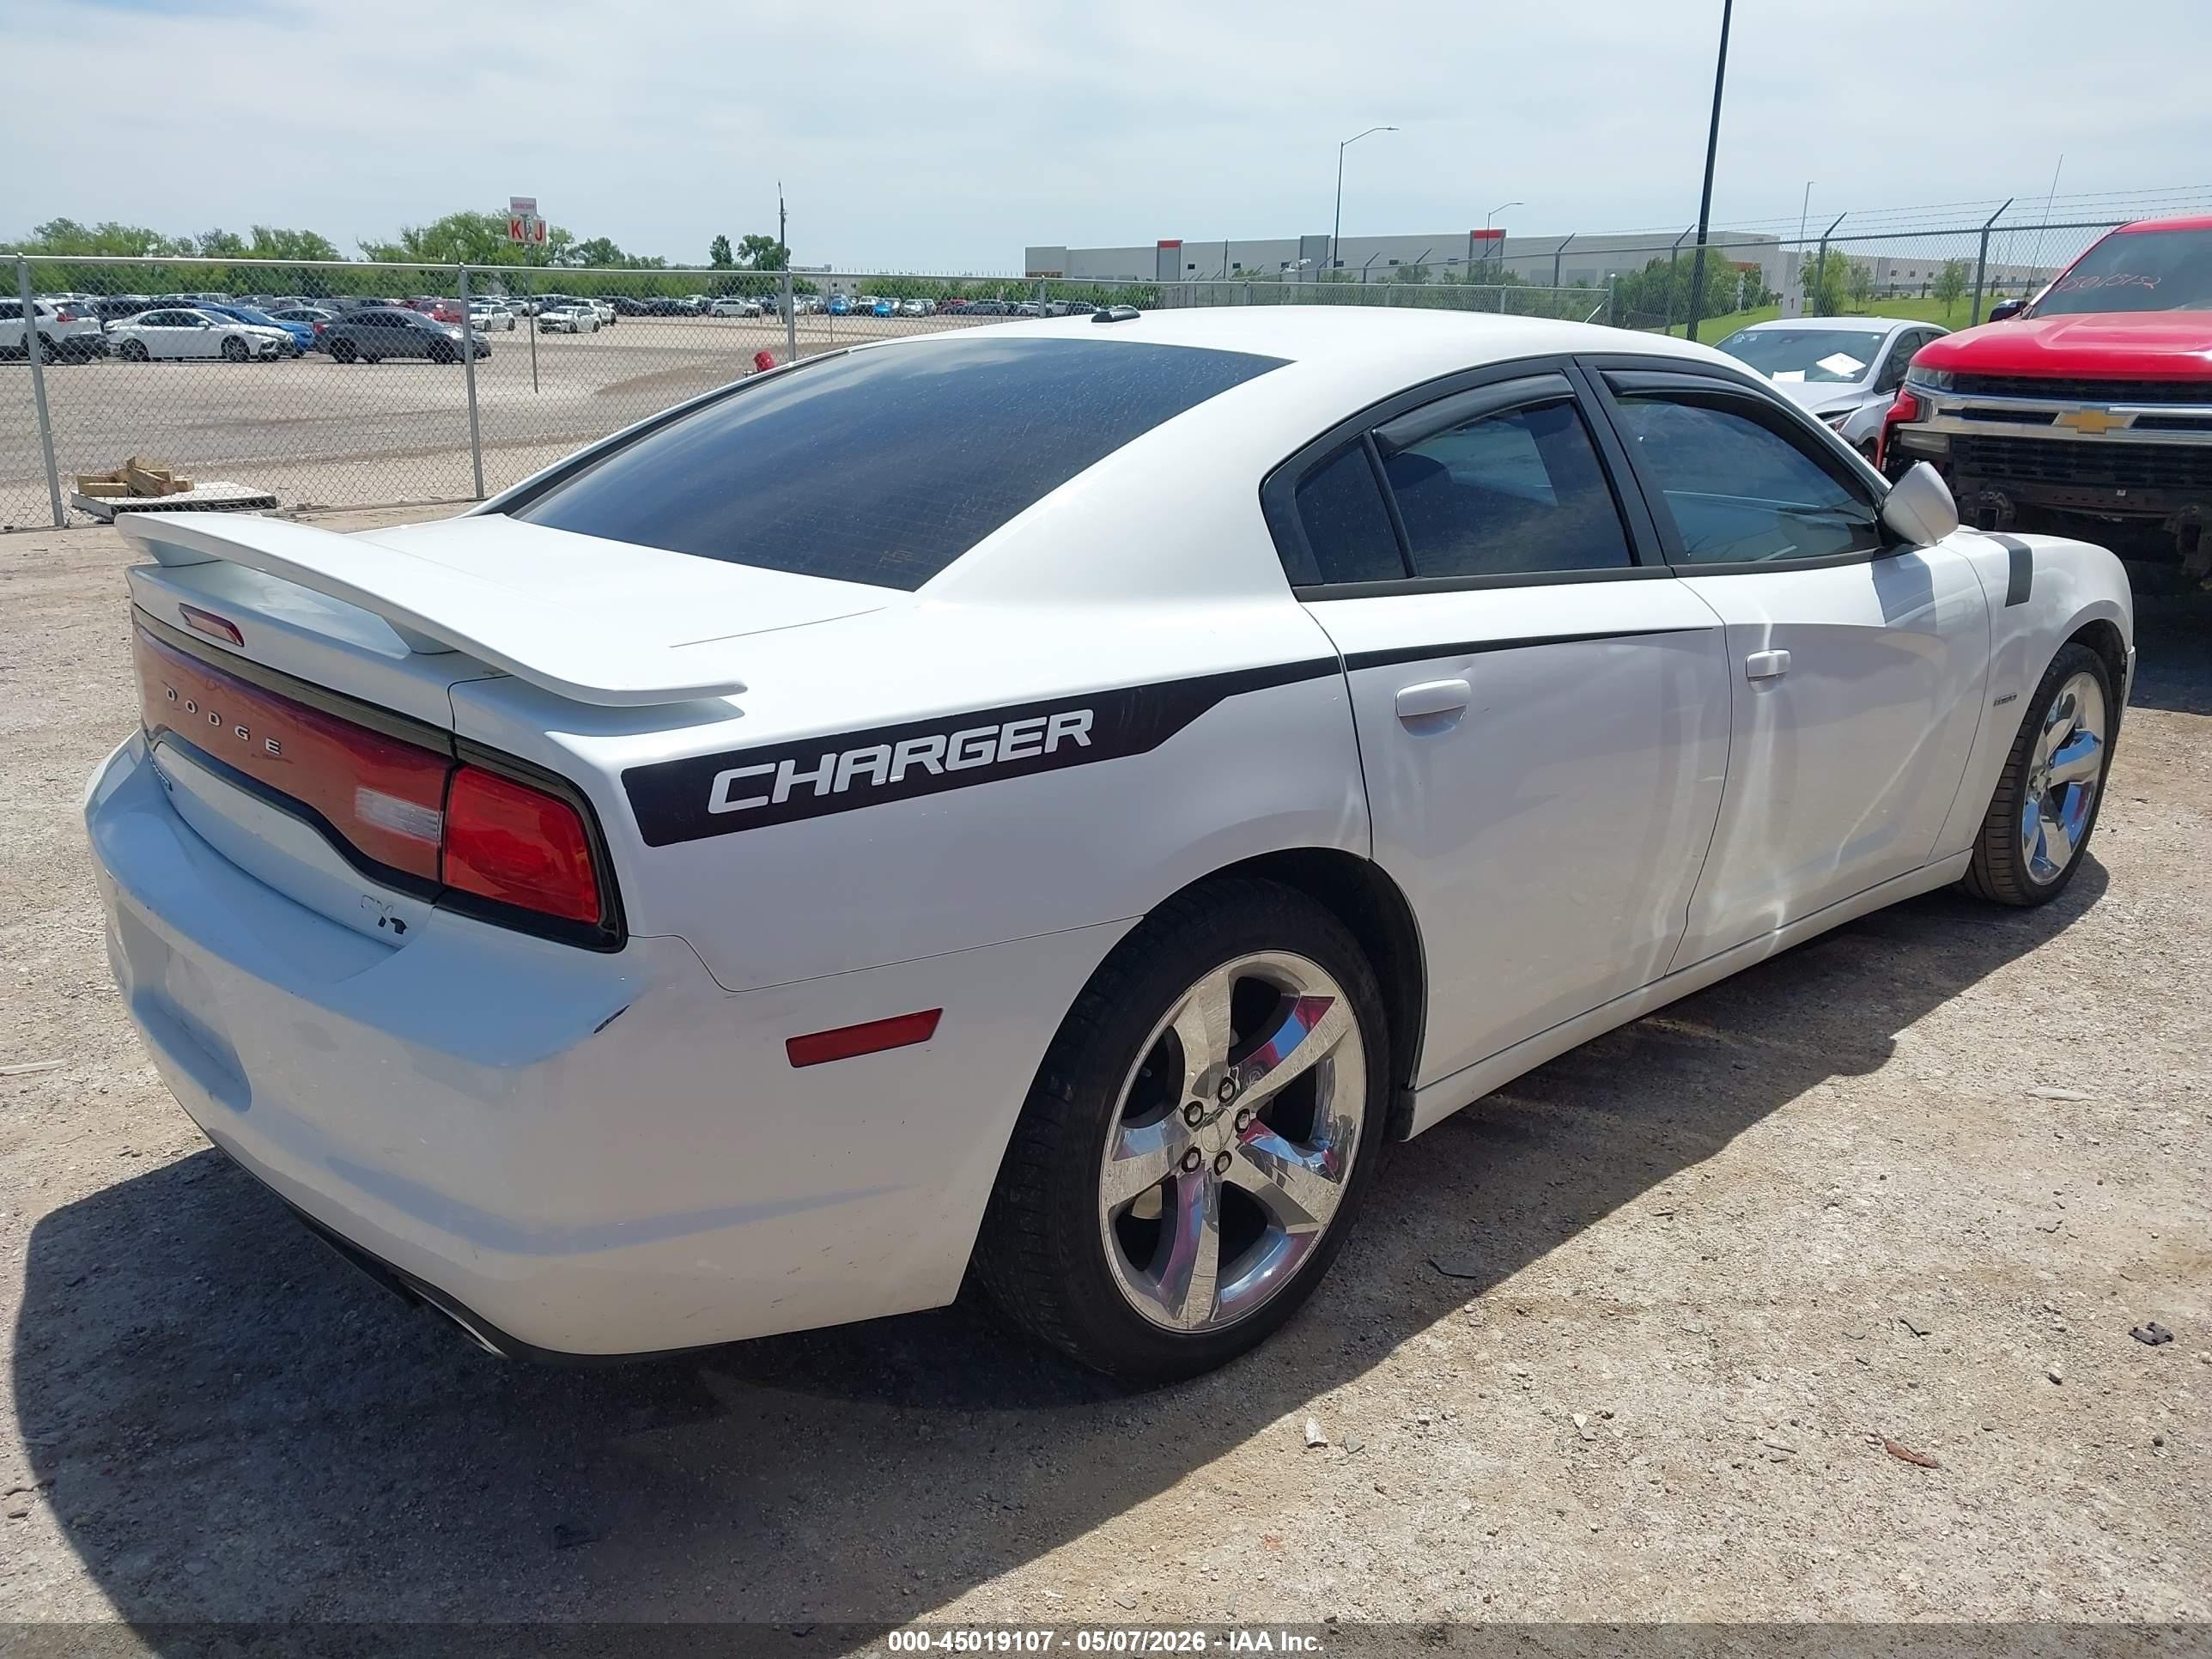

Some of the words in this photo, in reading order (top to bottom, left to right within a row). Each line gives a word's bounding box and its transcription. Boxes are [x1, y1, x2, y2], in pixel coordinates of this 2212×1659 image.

[511, 219, 523, 240] K
[534, 222, 544, 241] J
[167, 687, 283, 756] DODGE
[707, 708, 1095, 815] CHARGER
